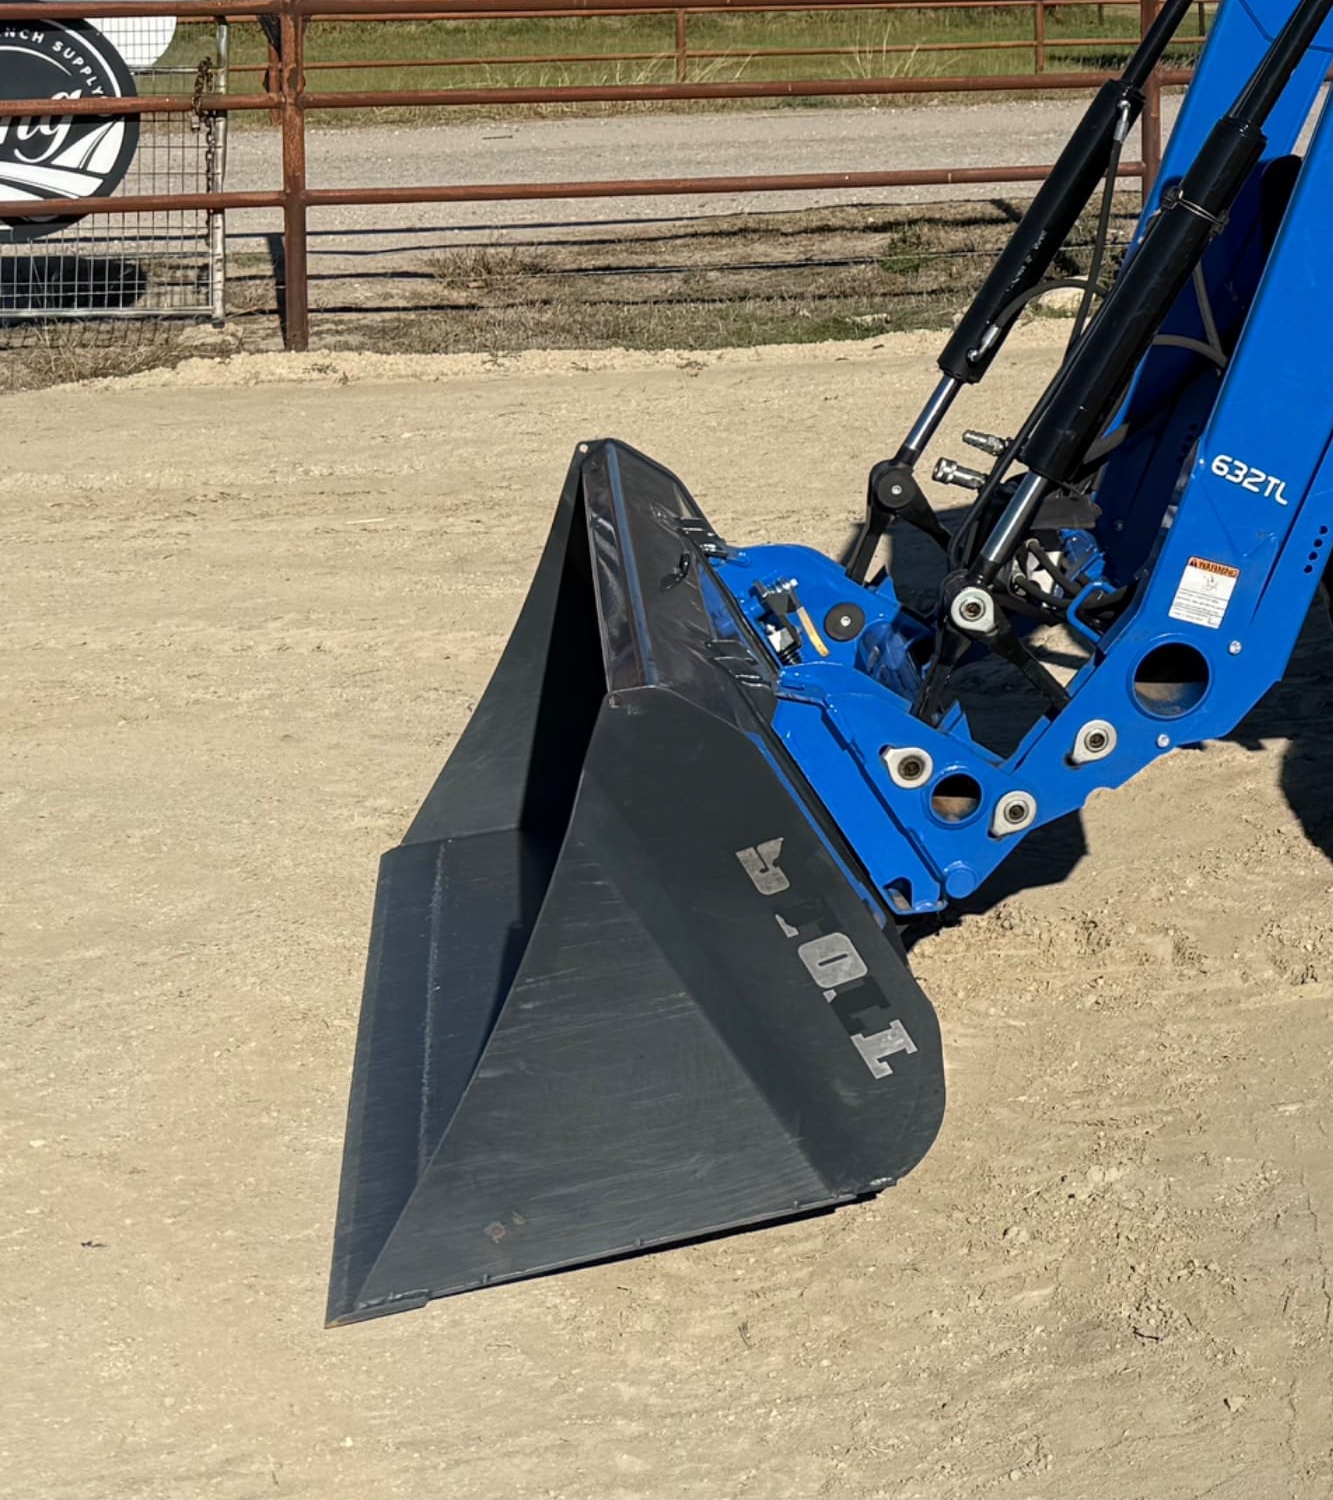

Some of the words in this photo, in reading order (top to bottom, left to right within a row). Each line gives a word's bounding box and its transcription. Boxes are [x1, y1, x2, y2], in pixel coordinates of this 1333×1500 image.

[0, 27, 45, 44] NCH
[52, 41, 104, 95] SUPPLY
[1210, 454, 1288, 506] 632TL
